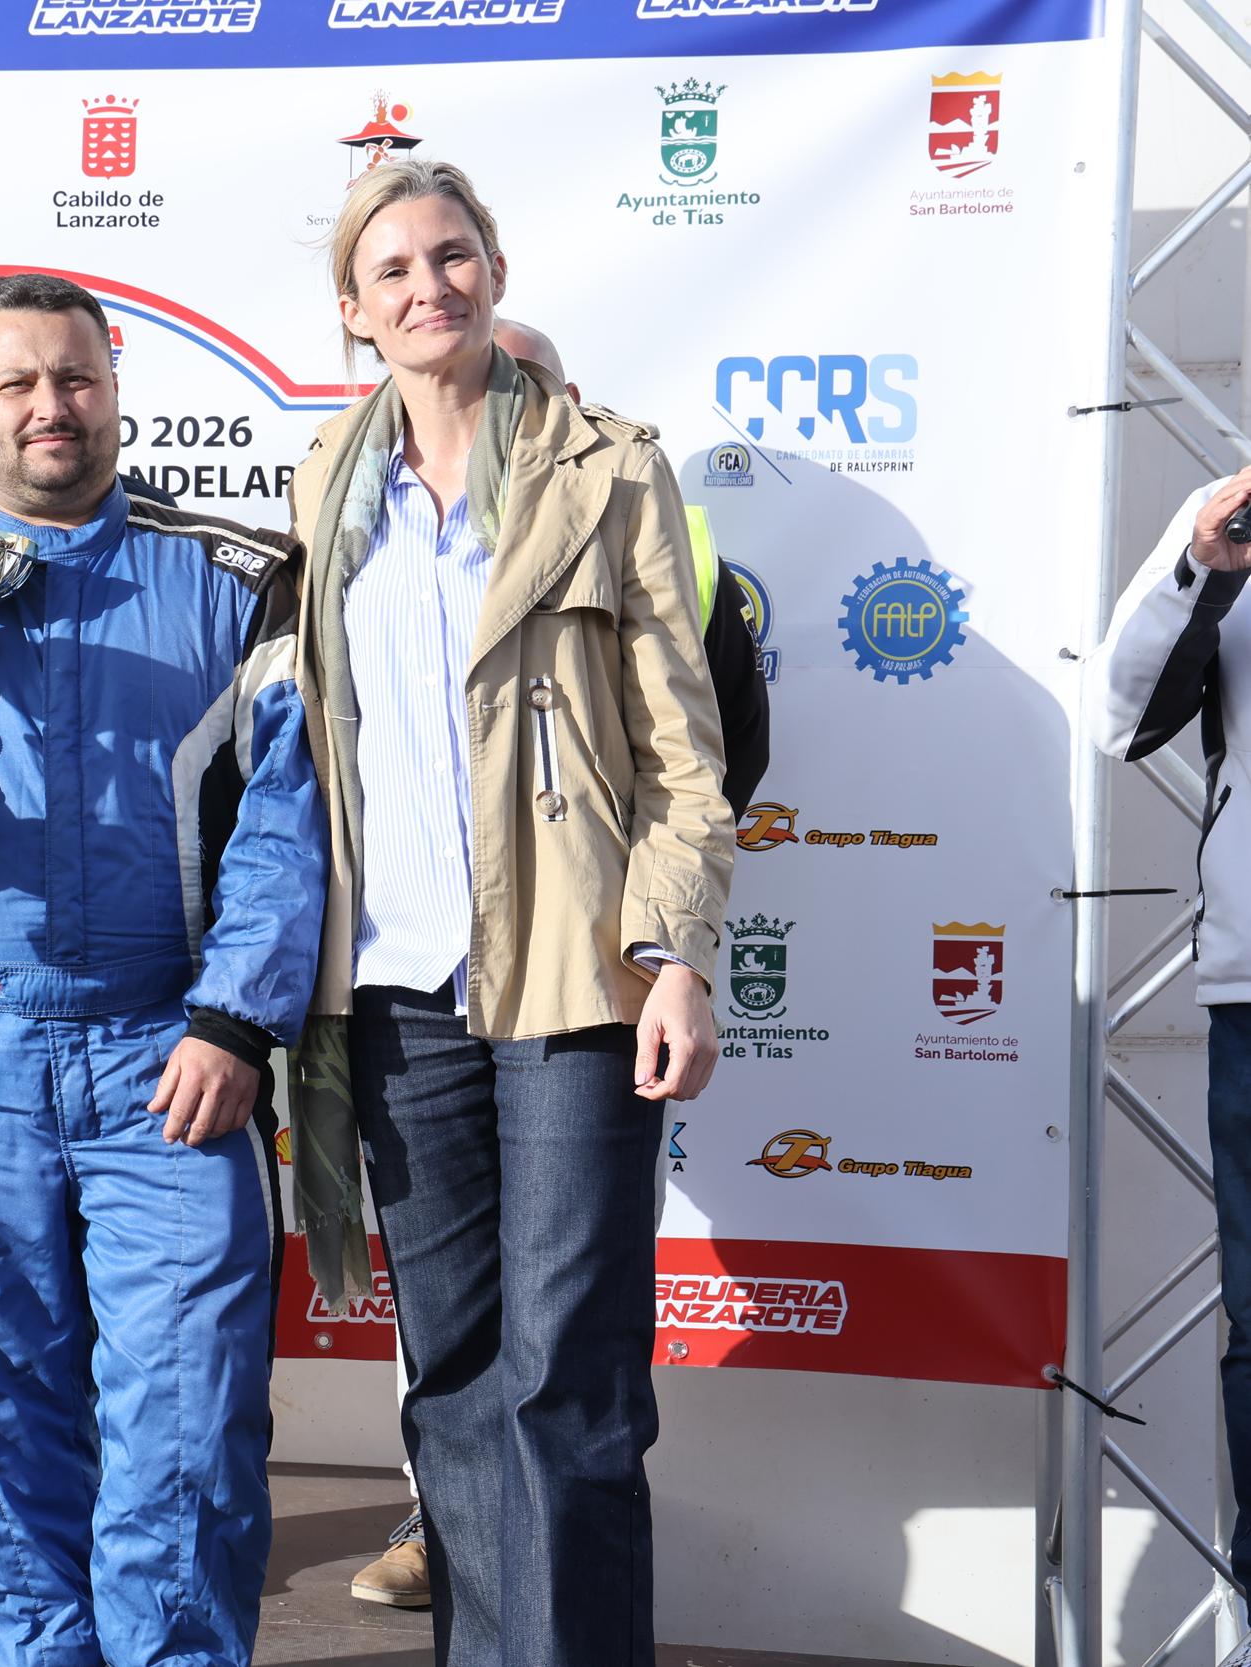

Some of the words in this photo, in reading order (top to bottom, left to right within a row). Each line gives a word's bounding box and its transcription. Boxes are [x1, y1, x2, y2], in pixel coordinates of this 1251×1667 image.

[34, 8, 254, 29] LANZAROTE
[333, 0, 559, 21] LANZAROTE
[52, 190, 133, 208] Cabildo
[138, 190, 164, 207] de
[616, 189, 761, 212] Ayuntamiento
[910, 187, 994, 202] Ayuntamiento
[997, 186, 1014, 198] de
[652, 210, 677, 226] de
[683, 208, 724, 225] Tías
[909, 204, 935, 216] San
[939, 201, 1013, 215] Bartolomé
[55, 211, 160, 228] Lanzarote
[306, 213, 337, 226] Servi
[715, 353, 919, 444] CCRS
[150, 415, 253, 448] 2026
[718, 452, 740, 471] FCA
[847, 450, 860, 460] DE
[864, 448, 915, 460] CANARIAS
[830, 462, 843, 473] DE
[847, 461, 915, 473] RALLYSPRINT
[215, 545, 266, 572] OMP
[805, 829, 866, 848] Grupo
[869, 829, 938, 849] Tiagua
[915, 1033, 999, 1046] Ayuntamiento
[1002, 1036, 1019, 1047] de
[722, 1042, 747, 1058] de
[752, 1042, 793, 1059] Tías
[915, 1047, 941, 1060] San
[945, 1048, 1019, 1062] Bartolomé
[837, 1157, 900, 1178] Grupo
[903, 1160, 973, 1181] Tiagua
[655, 1279, 843, 1308] SCUDERIA
[655, 1303, 842, 1330] NZAROTE
